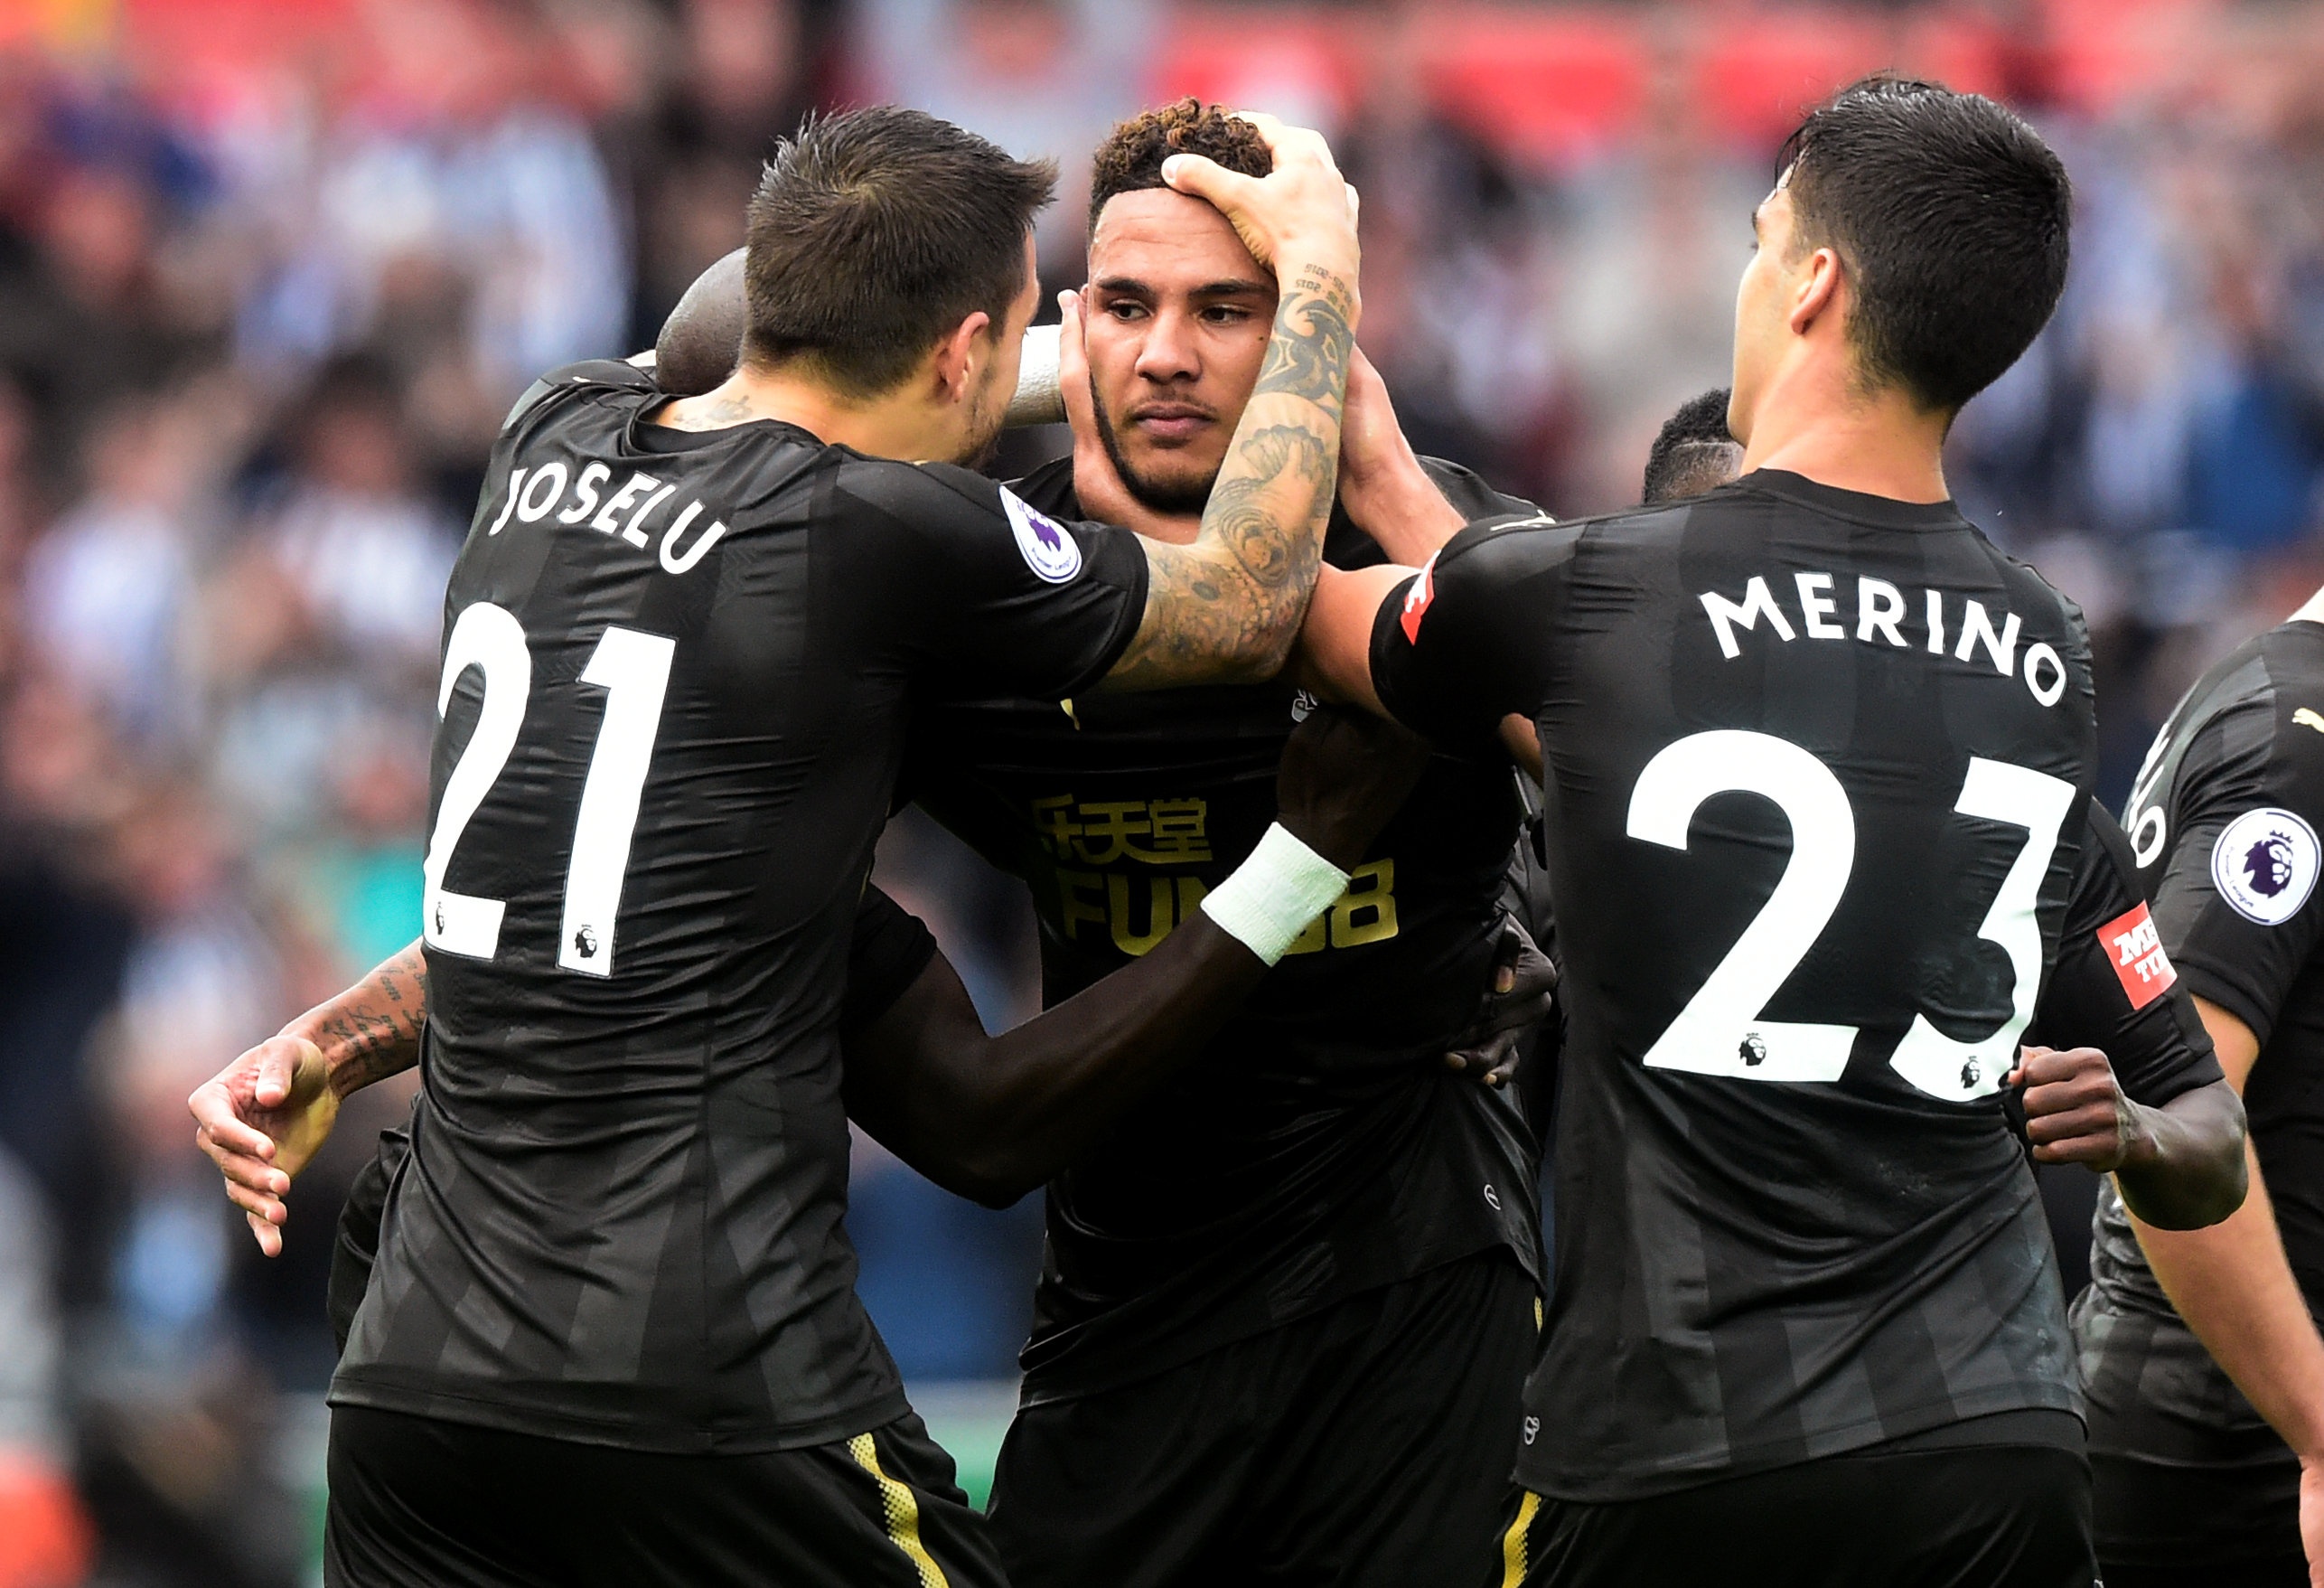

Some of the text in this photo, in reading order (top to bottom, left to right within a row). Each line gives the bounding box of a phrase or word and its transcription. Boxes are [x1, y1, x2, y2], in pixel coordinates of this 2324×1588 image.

[489, 460, 728, 576] JOSELU
[1698, 571, 2066, 708] MERINO
[421, 600, 677, 978] 21
[1030, 793, 1214, 865] 乐天堂
[1055, 858, 1400, 958] FU8
[1626, 729, 2076, 1104] 23
